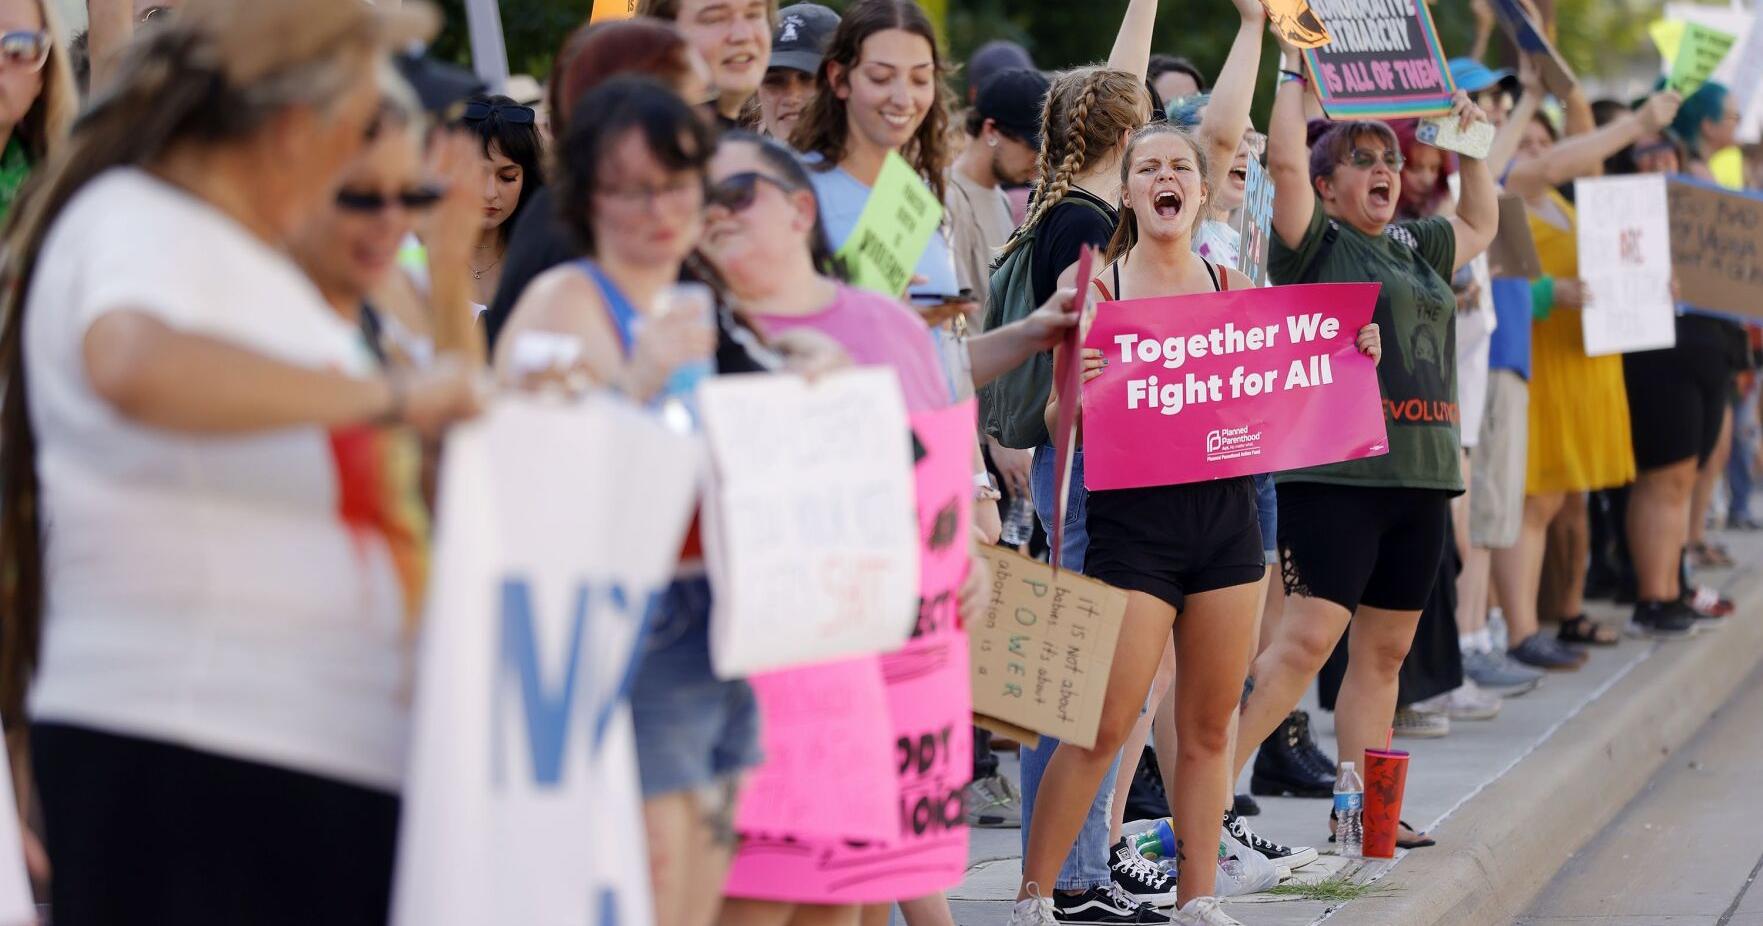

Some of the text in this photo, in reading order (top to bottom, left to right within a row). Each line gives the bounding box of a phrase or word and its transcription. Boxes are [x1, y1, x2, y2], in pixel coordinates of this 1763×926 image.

[1323, 17, 1412, 54] ATRIARCHY
[1341, 61, 1376, 93] ALL
[1370, 60, 1395, 90] OF
[1393, 57, 1442, 89] THEM
[1114, 313, 1340, 369] Together We
[1127, 353, 1334, 416] Fight for All
[1221, 425, 1249, 437] Planned
[1221, 431, 1262, 445] Parenthood
[985, 560, 1012, 630] abortion
[1002, 578, 1048, 698] POWER
[977, 664, 988, 676] a
[1034, 666, 1054, 704] about
[1056, 679, 1080, 723] about
